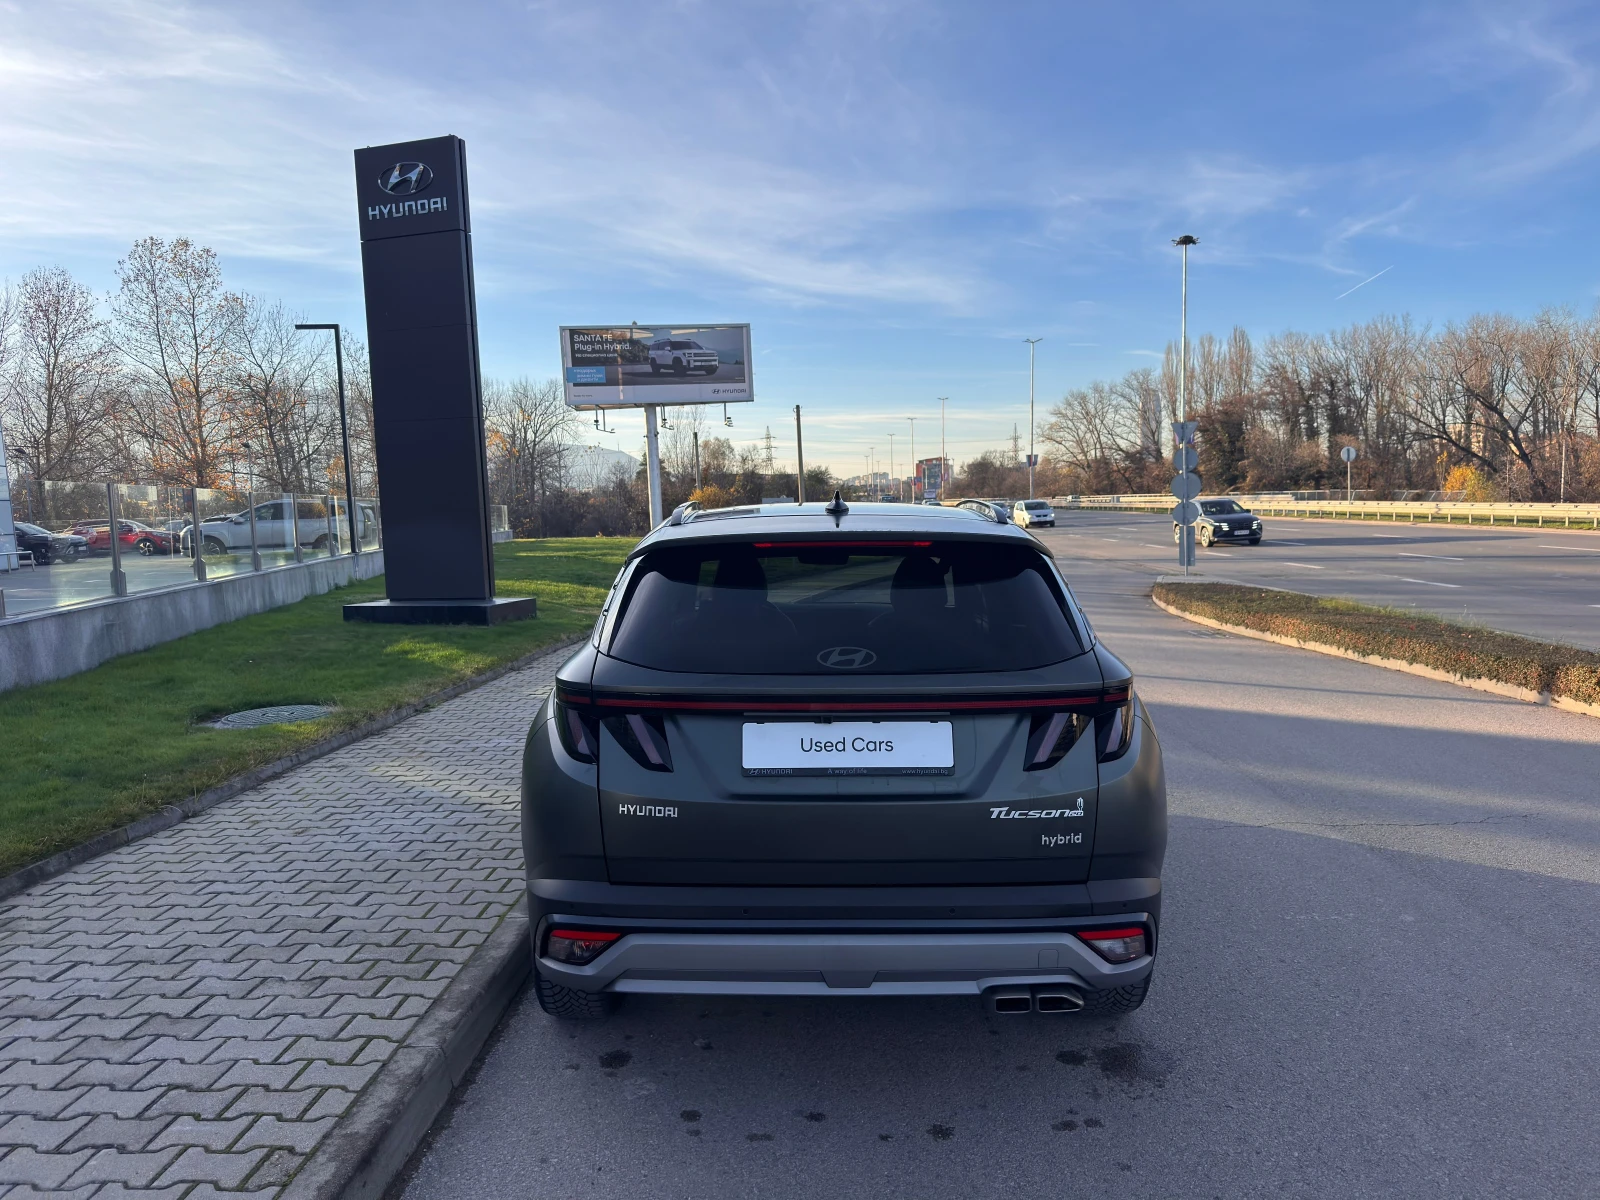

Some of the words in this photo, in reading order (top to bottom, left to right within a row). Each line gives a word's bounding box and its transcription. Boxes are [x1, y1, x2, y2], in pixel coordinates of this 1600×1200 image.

[368, 196, 448, 221] HYUNDAI
[573, 334, 602, 342] SANTA
[602, 334, 613, 342] FE
[574, 342, 602, 351] Plug-in
[603, 342, 632, 351] Hybrid.
[800, 736, 846, 753] Used
[851, 736, 894, 753] Cars
[901, 768, 949, 776] www.hyundai.bg
[618, 803, 679, 818] HYUNDAI
[989, 806, 1070, 819] Tucson
[1041, 832, 1082, 847] hybrid
